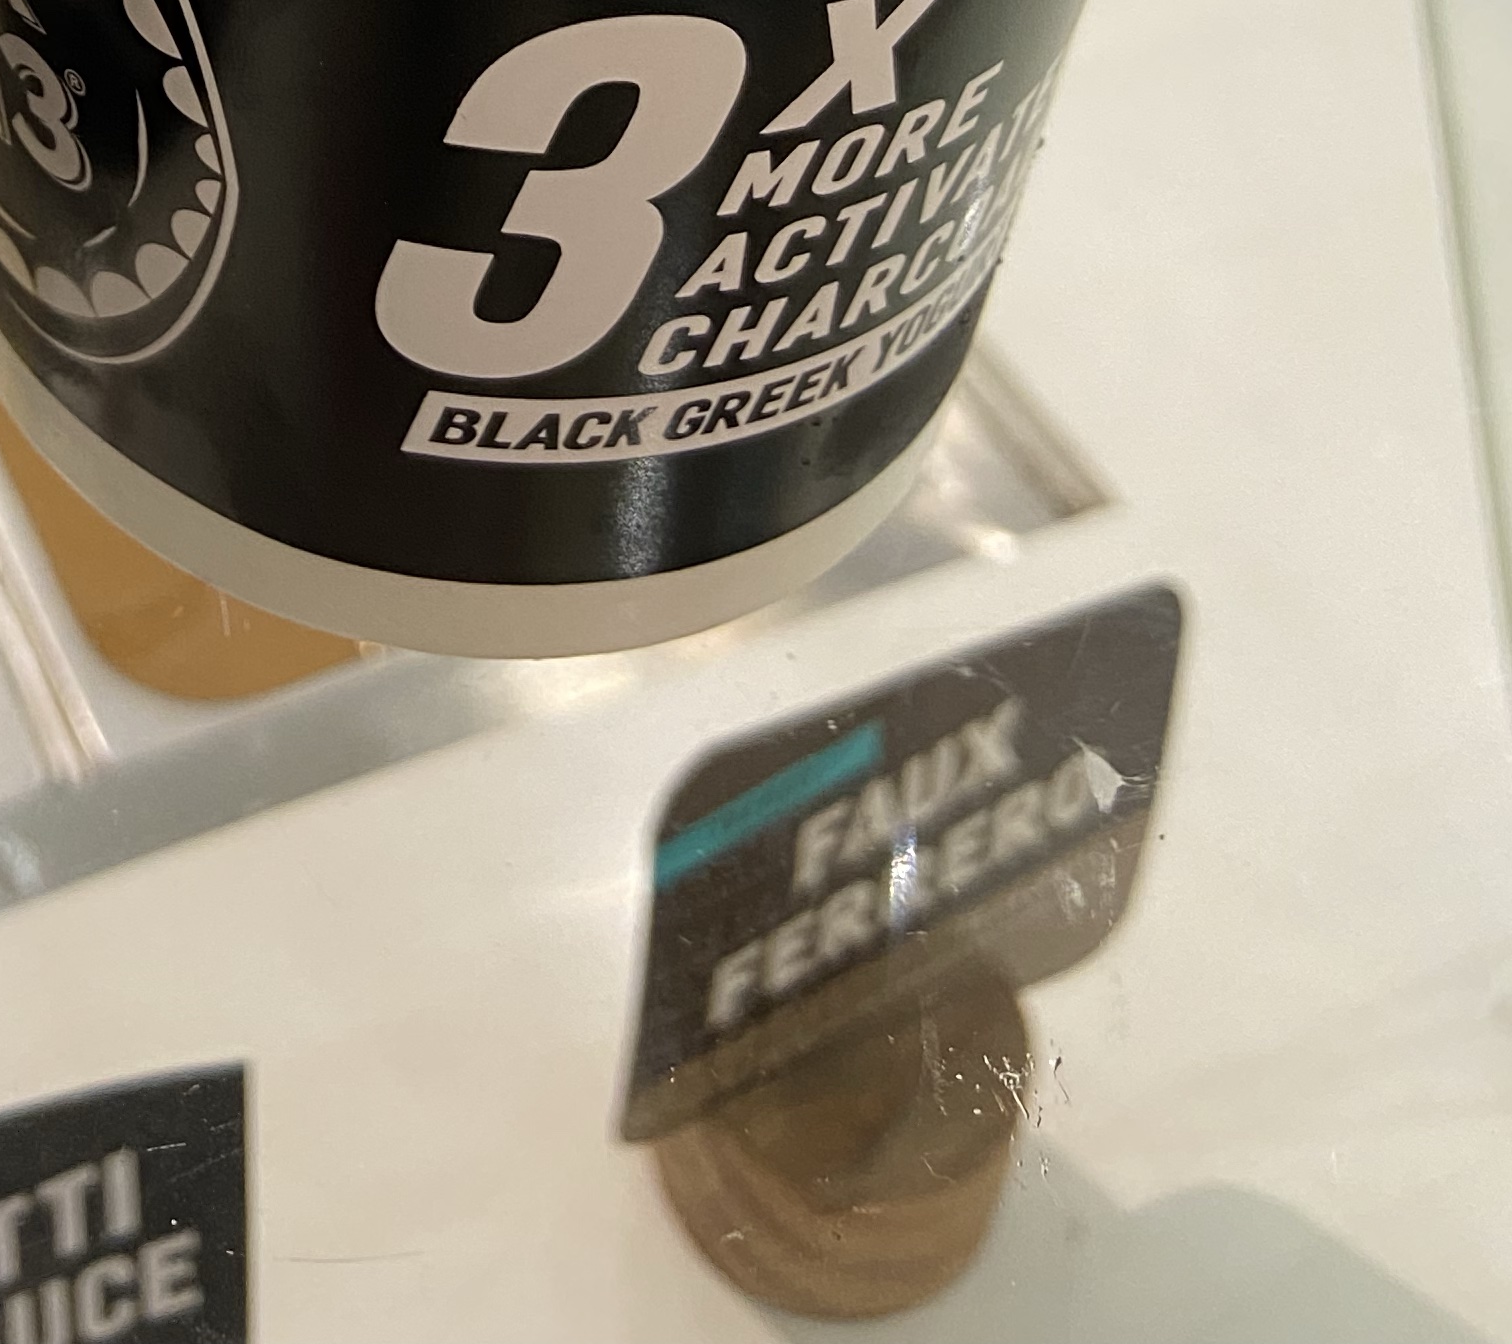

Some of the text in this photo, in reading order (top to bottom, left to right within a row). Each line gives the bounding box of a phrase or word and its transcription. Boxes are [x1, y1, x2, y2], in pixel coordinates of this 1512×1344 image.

[716, 60, 1005, 216] MORE
[428, 405, 658, 451] BLACK
[662, 346, 864, 441] GREEK
[791, 694, 1025, 896] FAUX
